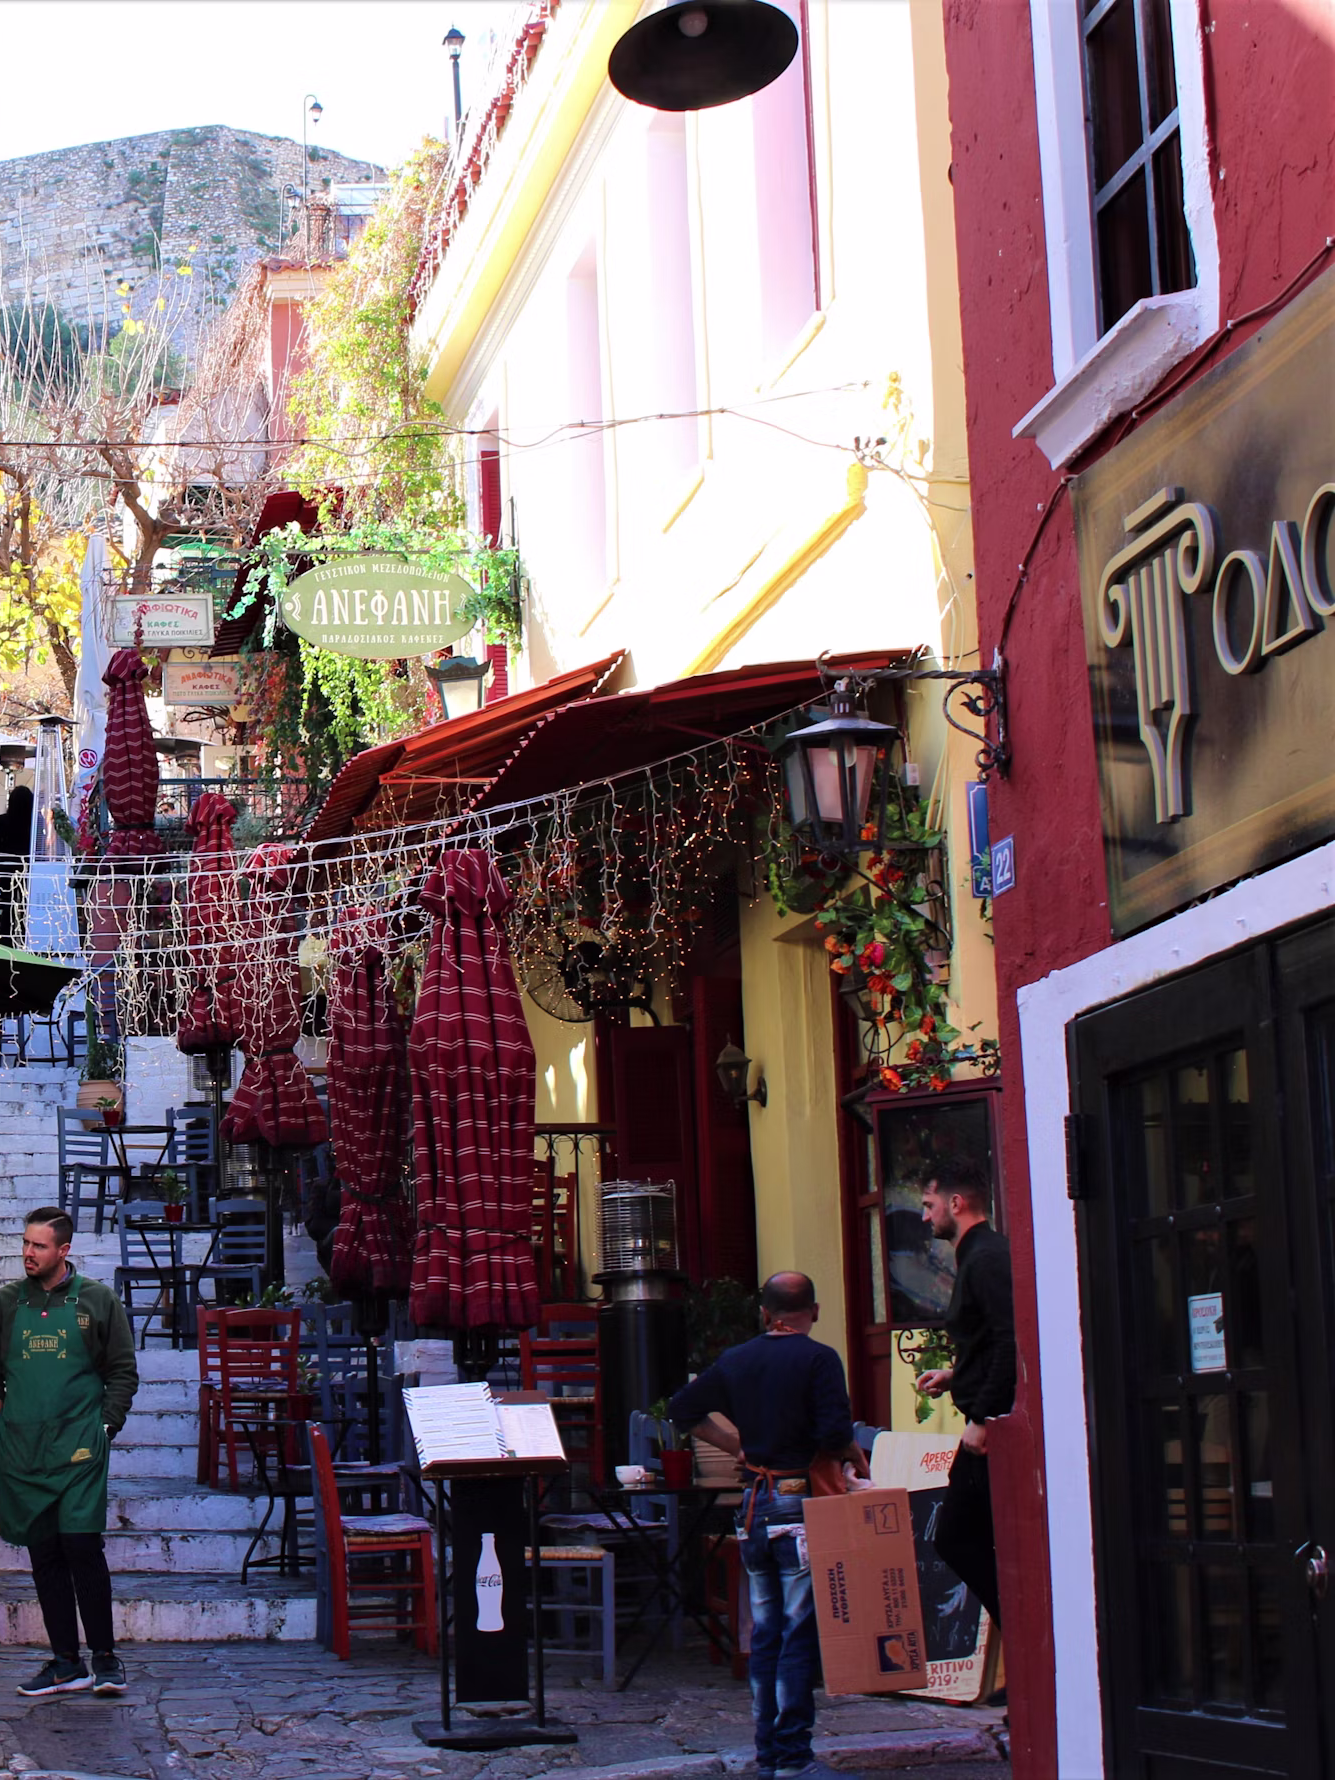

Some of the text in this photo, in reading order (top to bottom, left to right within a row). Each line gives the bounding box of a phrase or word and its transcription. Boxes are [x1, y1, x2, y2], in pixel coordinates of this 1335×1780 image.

[314, 564, 366, 583] ΓΕΥΣΤΙΚΟΝ
[310, 589, 453, 626] ΑΝΕΦΑΝΗ
[147, 620, 181, 628] ΚΑΦΕΣ
[321, 634, 445, 644] ΠΑΡΑΔΟΣΙΑΚΟΣ ΚΑΦΕΝΕΣ
[996, 848, 1011, 884] 22
